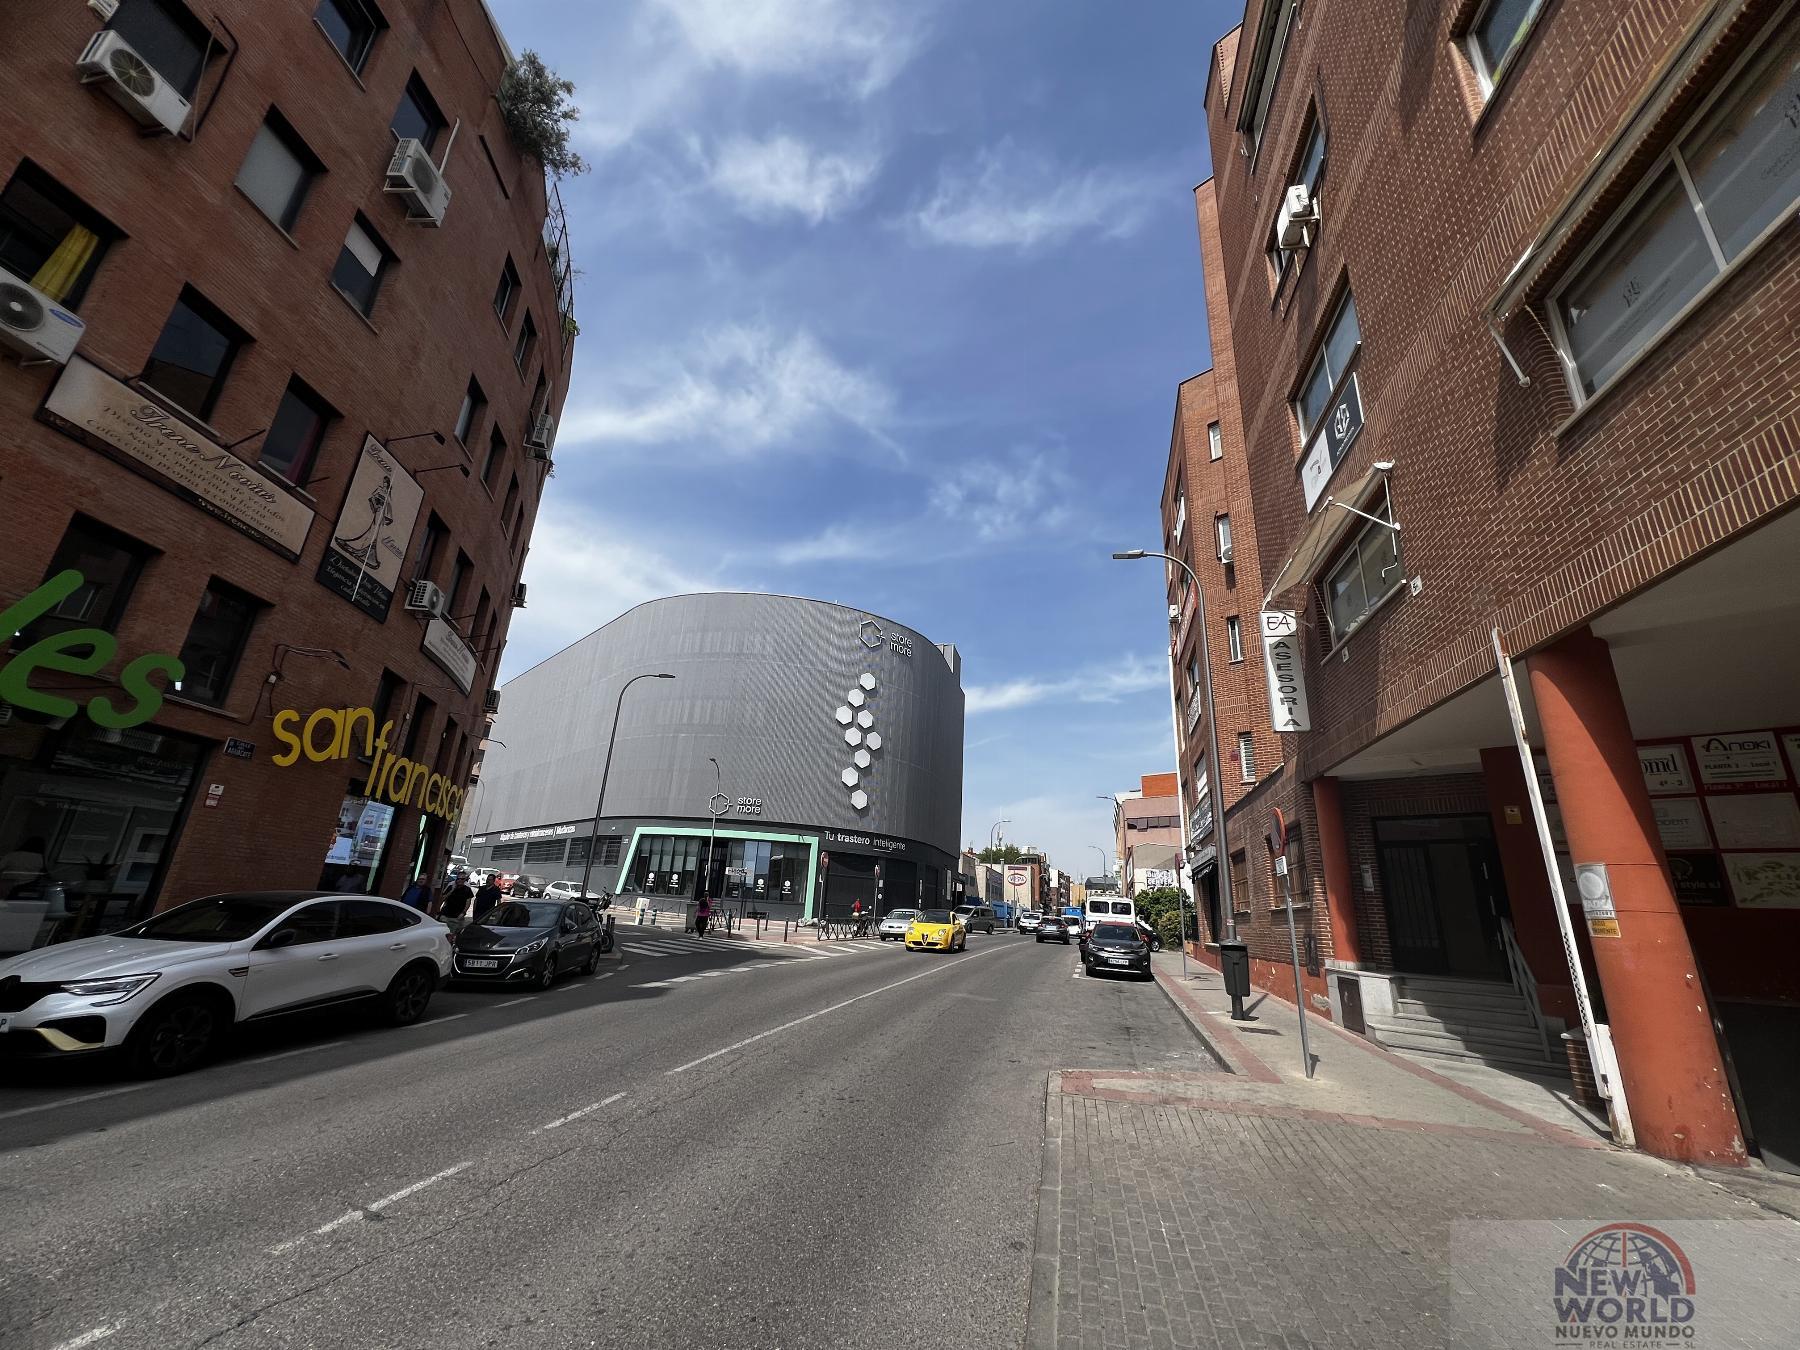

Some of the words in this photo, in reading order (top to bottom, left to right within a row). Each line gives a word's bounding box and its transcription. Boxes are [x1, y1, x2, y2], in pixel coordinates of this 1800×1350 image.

[130, 405, 201, 454] Irene
[199, 453, 277, 504] Novias
[891, 632, 912, 647] store
[890, 641, 912, 657] more
[1273, 641, 1302, 727] ASESORIA
[272, 707, 375, 767] san
[737, 796, 762, 806] store
[737, 804, 761, 814] more
[824, 831, 834, 841] Tu
[837, 832, 870, 845] trastero
[873, 837, 906, 850] inteligente
